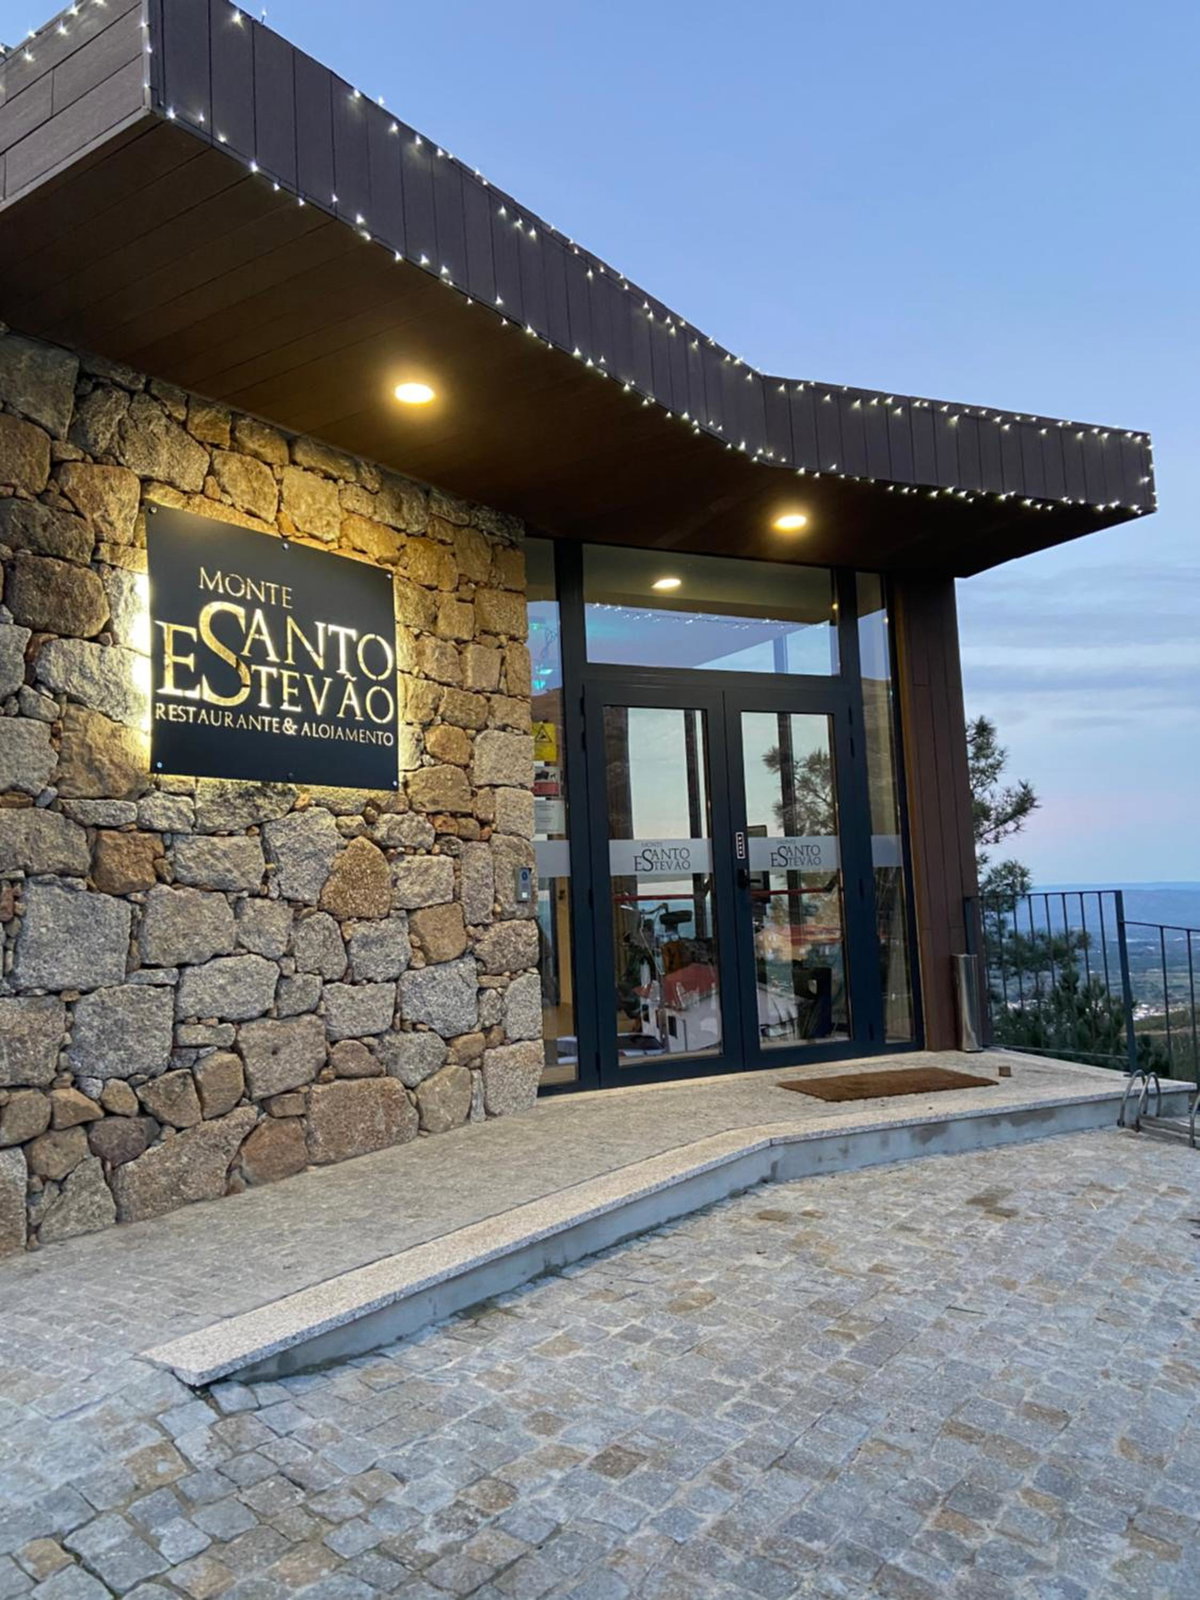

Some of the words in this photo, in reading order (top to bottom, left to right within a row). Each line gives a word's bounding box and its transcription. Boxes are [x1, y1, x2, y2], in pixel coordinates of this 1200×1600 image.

[199, 566, 293, 609] MONTE
[155, 602, 394, 723] ESTEVÃO
[199, 601, 394, 706] SANTO
[155, 702, 280, 733] RESTAURANTE
[641, 847, 690, 872] SANTO
[777, 844, 821, 867] SANTO
